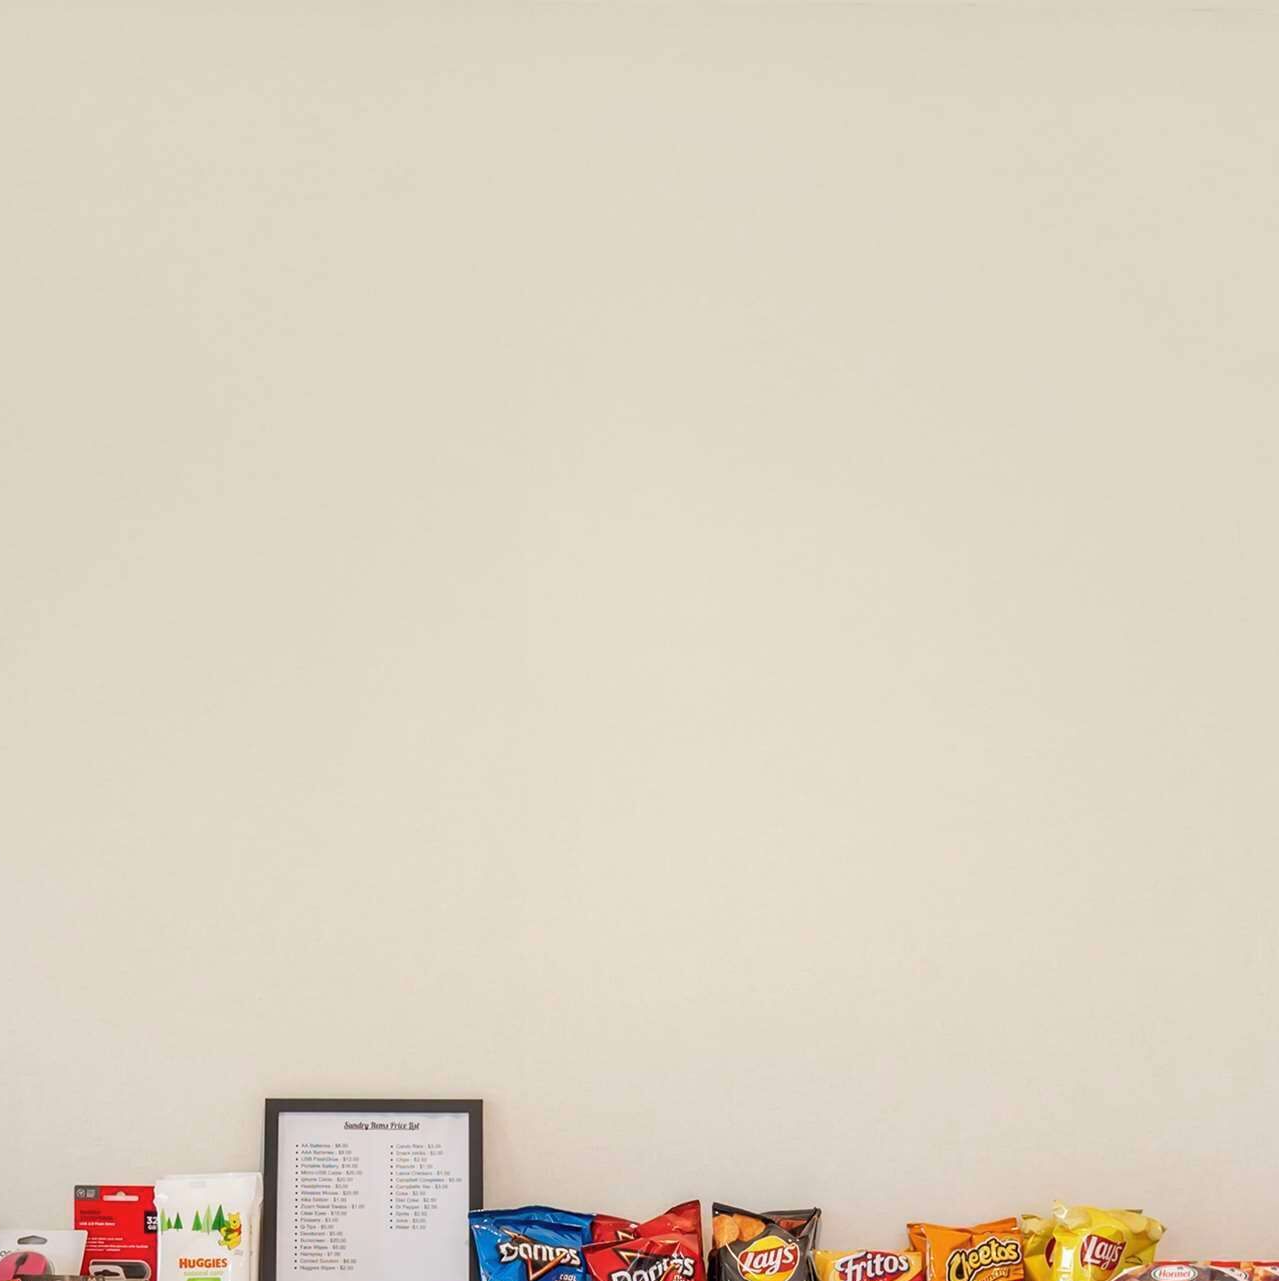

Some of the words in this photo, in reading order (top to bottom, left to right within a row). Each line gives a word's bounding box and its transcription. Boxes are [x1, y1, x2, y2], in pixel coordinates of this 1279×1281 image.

[498, 1241, 582, 1267] Doritos
[178, 1257, 229, 1269] HUGGIES
[559, 1274, 577, 1281] COOL
